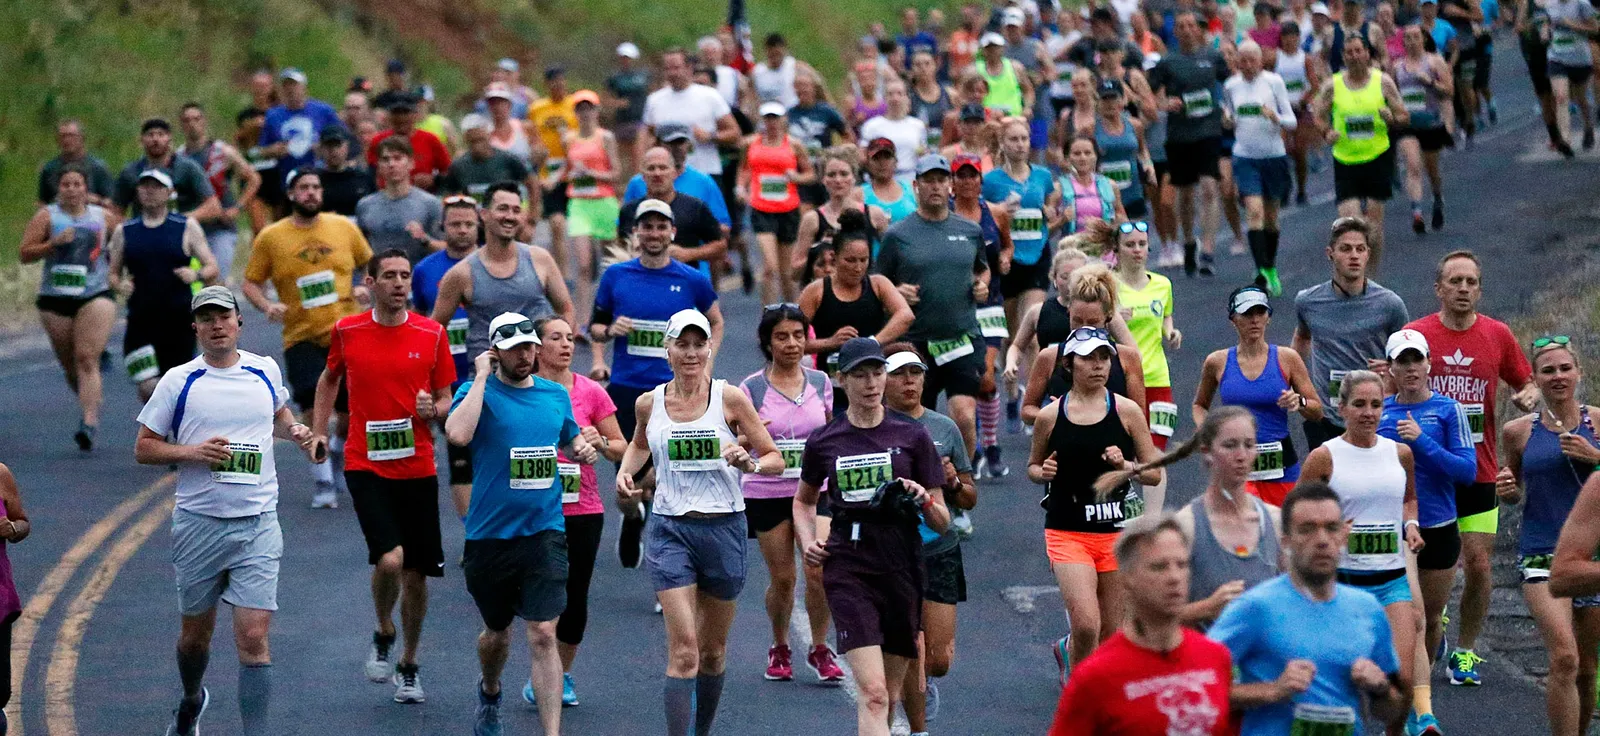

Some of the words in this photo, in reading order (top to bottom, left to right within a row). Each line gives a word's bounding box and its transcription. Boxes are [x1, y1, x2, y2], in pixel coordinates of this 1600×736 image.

[371, 430, 409, 450] 1381
[674, 439, 714, 460] 1339
[216, 452, 256, 473] 140
[516, 459, 552, 479] 1389
[843, 466, 886, 490] 1214
[1085, 501, 1124, 522] PINK
[1355, 533, 1393, 554] 1811
